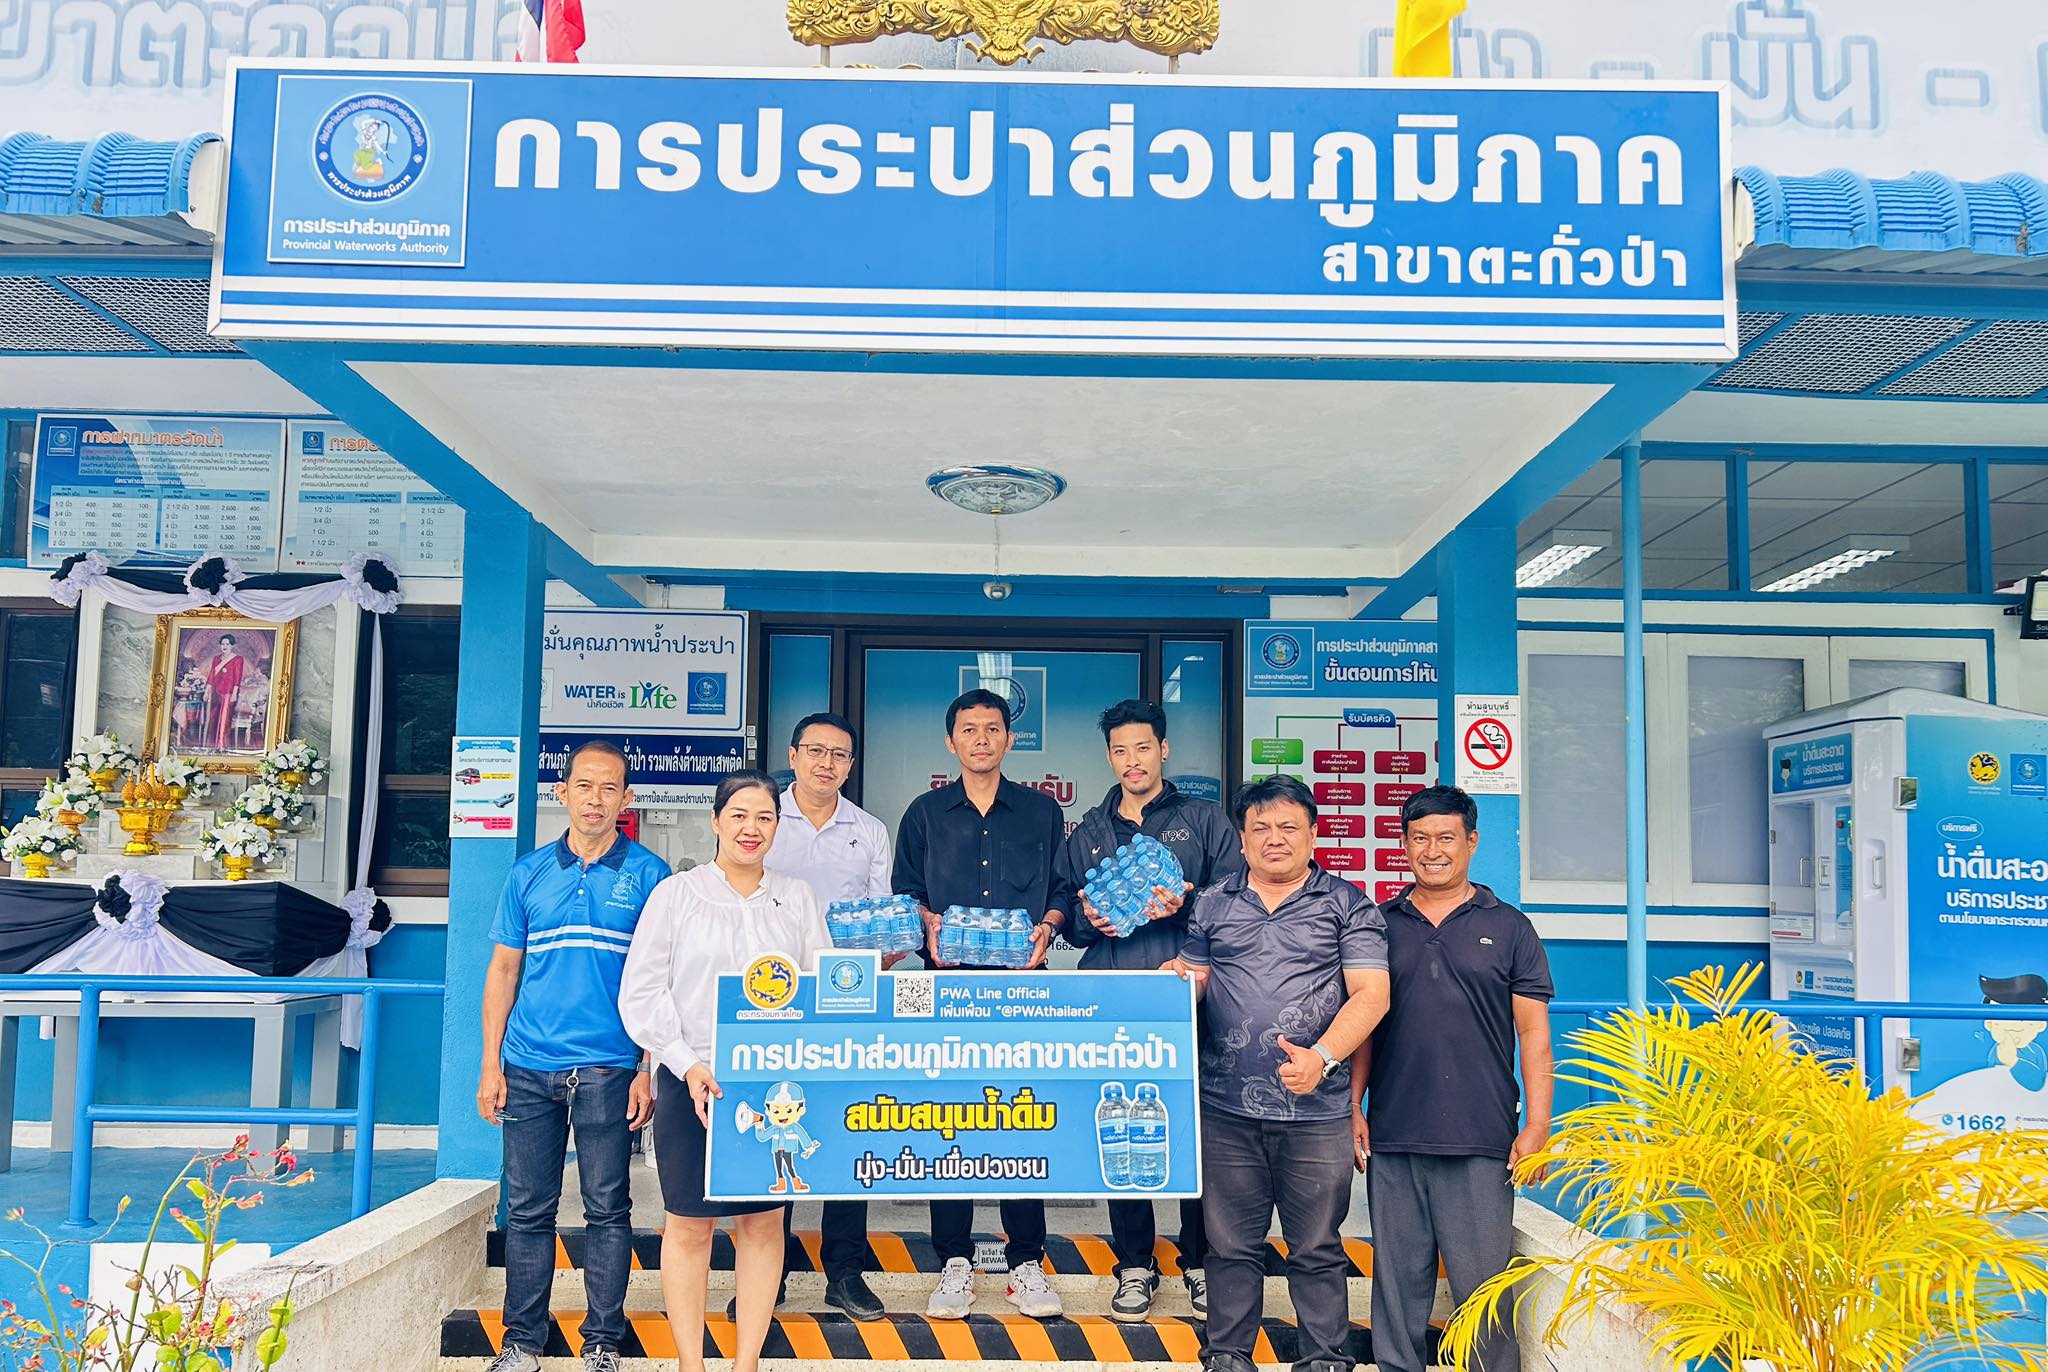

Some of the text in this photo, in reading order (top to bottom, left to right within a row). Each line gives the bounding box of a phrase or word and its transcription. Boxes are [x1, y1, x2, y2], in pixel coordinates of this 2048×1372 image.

[494, 104, 1683, 227] การประปาส่วนภูมิภาค
[283, 217, 451, 239] การประปาส่วนภูมิภาค
[283, 239, 449, 256] Provincial Waterworks Authority
[1322, 224, 1687, 287] สาขาตะกั่วป่า
[544, 624, 735, 660] มั่นคุณภาพน้ำประปา
[1316, 638, 1438, 656] การประปาส่วนภูมิภาคสา
[564, 684, 615, 699] WATER
[1348, 713, 1391, 724] รับบัตรคิว
[940, 987, 1050, 999] PWA Line Official
[738, 1008, 802, 1018] กระทรวงมหาดไทย
[940, 1001, 990, 1018] เพิ่มเพื่อน
[731, 1027, 1177, 1079] การประปาส่วนภูมิภาคสาขาตะกั่วป่า
[846, 1087, 1055, 1139] สนับสนุนน้ำดื่ม
[1957, 1115, 2006, 1130] 1662
[855, 1147, 1048, 1191] มุ่ง-มั่น-เพื่อปวงชน
